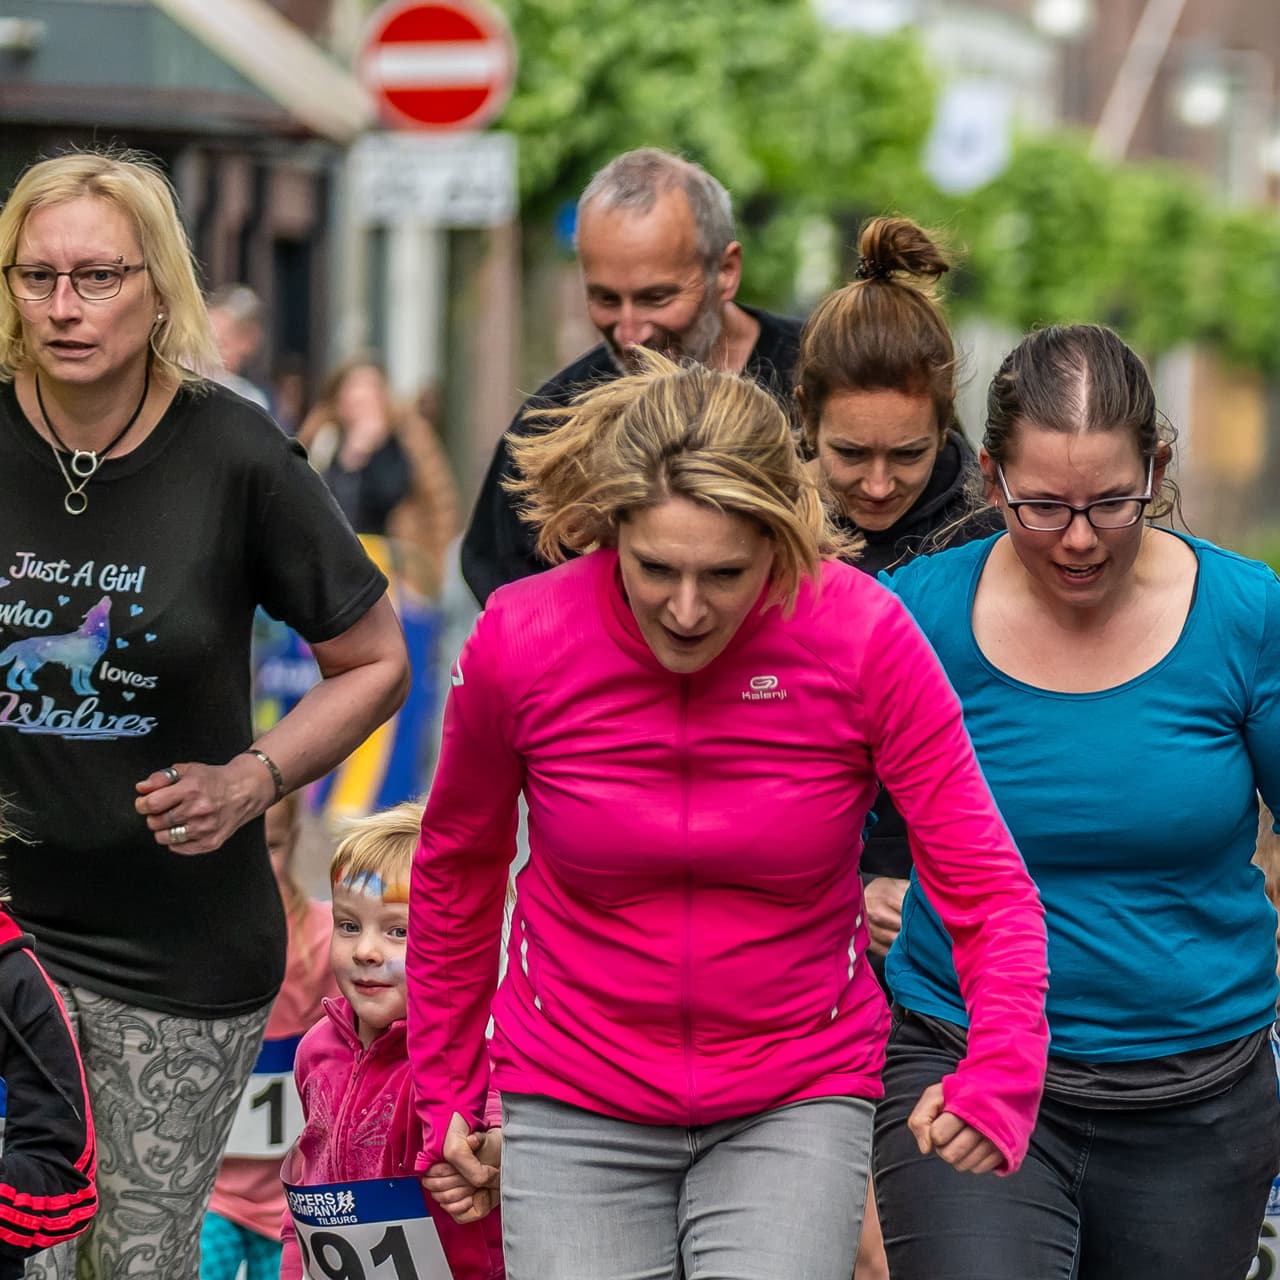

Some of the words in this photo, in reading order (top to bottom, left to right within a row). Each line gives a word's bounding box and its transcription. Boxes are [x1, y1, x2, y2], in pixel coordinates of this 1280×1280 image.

[9, 551, 71, 583] Just
[71, 561, 95, 587] A
[99, 564, 146, 593] Girl
[0, 600, 53, 629] who
[99, 661, 159, 689] loves
[0, 691, 159, 735] Wolves
[316, 1215, 358, 1225] TILBURG
